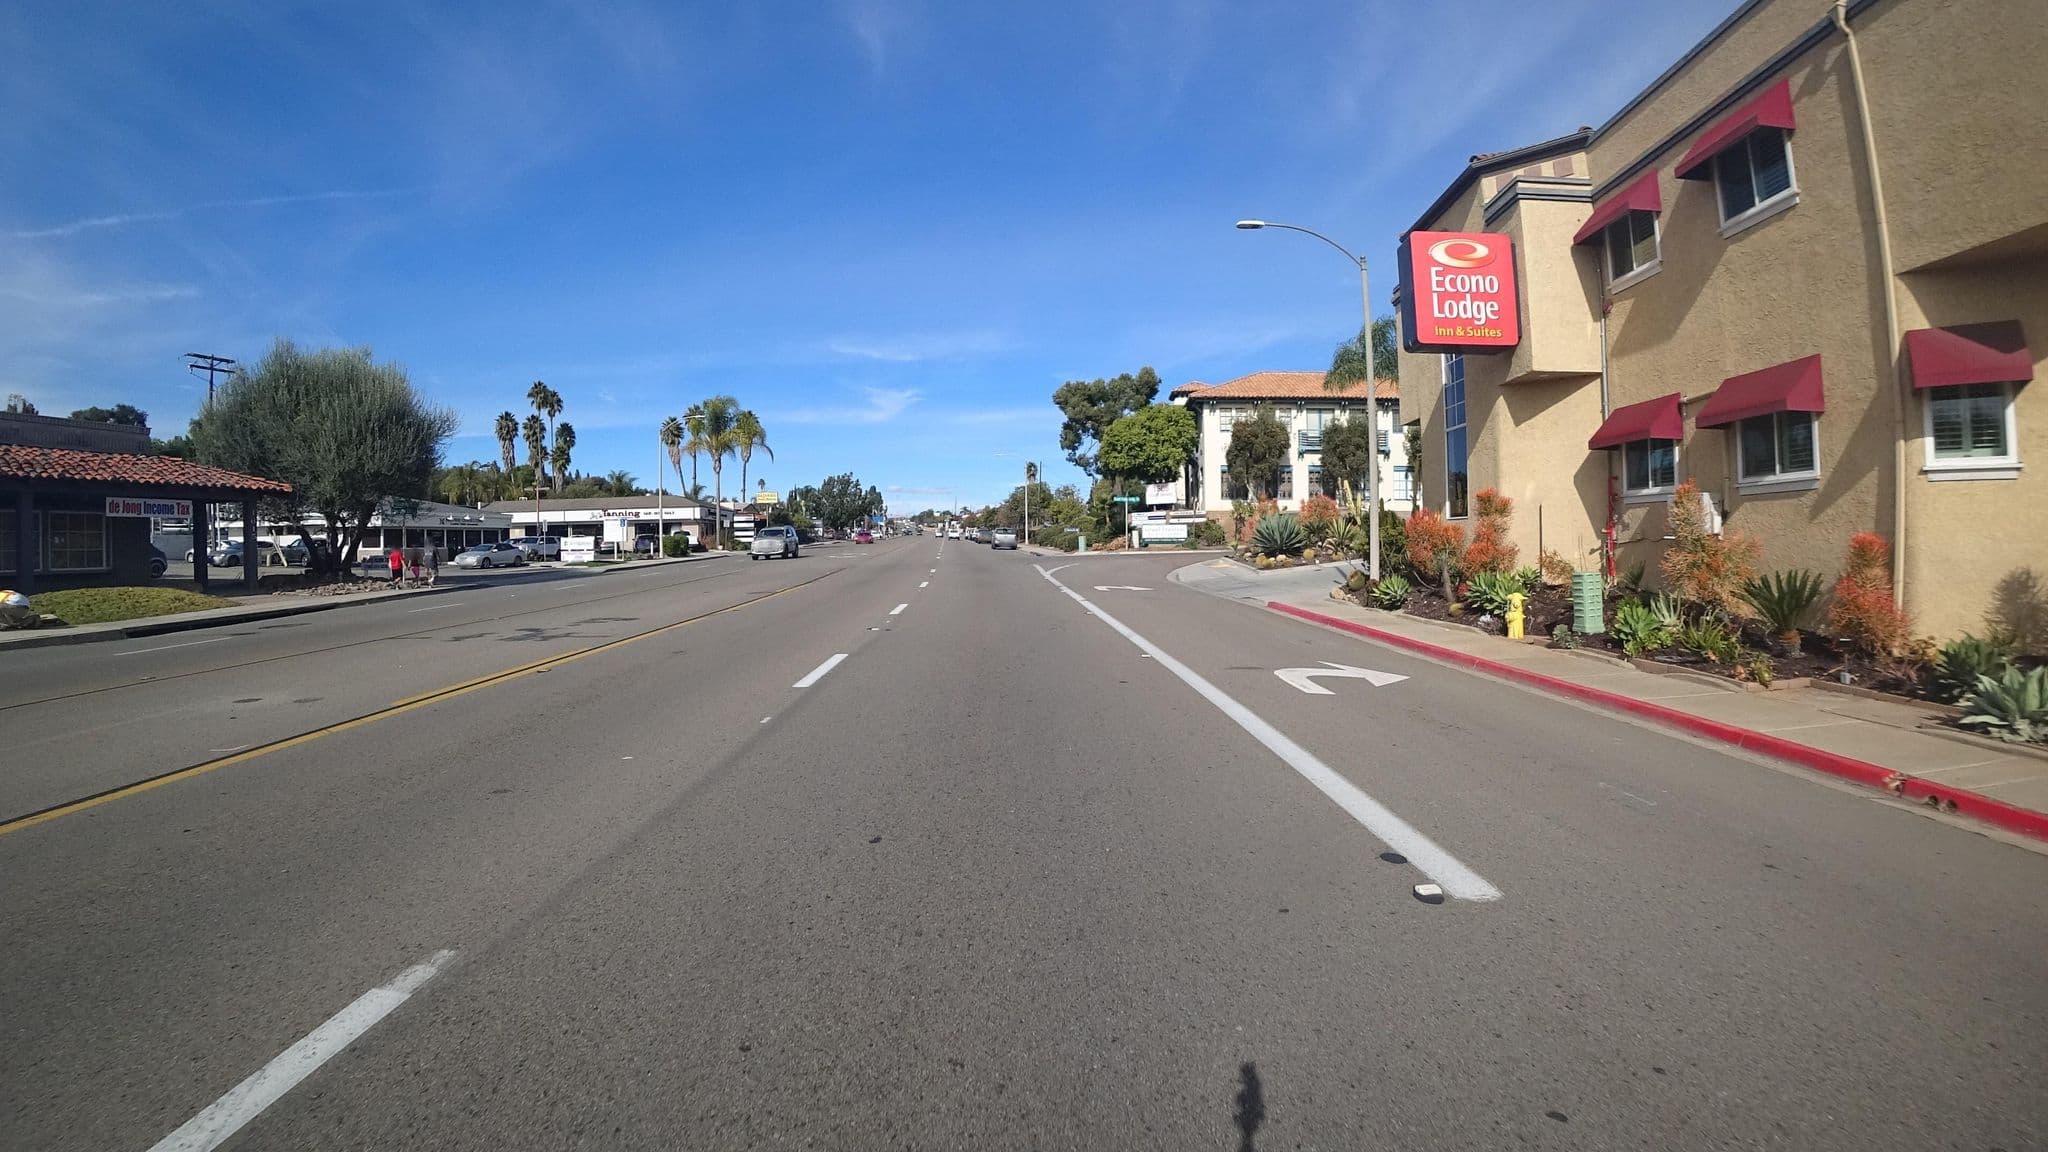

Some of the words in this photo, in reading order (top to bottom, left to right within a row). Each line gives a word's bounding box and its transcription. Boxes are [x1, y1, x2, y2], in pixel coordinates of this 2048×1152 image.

[1430, 267, 1499, 293] Econo
[1432, 293, 1500, 325] Lodge
[1456, 326, 1465, 337] &
[1467, 326, 1502, 337] Suites
[109, 499, 120, 514] de
[122, 500, 142, 515] Jong
[144, 501, 175, 515] Income
[176, 502, 191, 515] Tax
